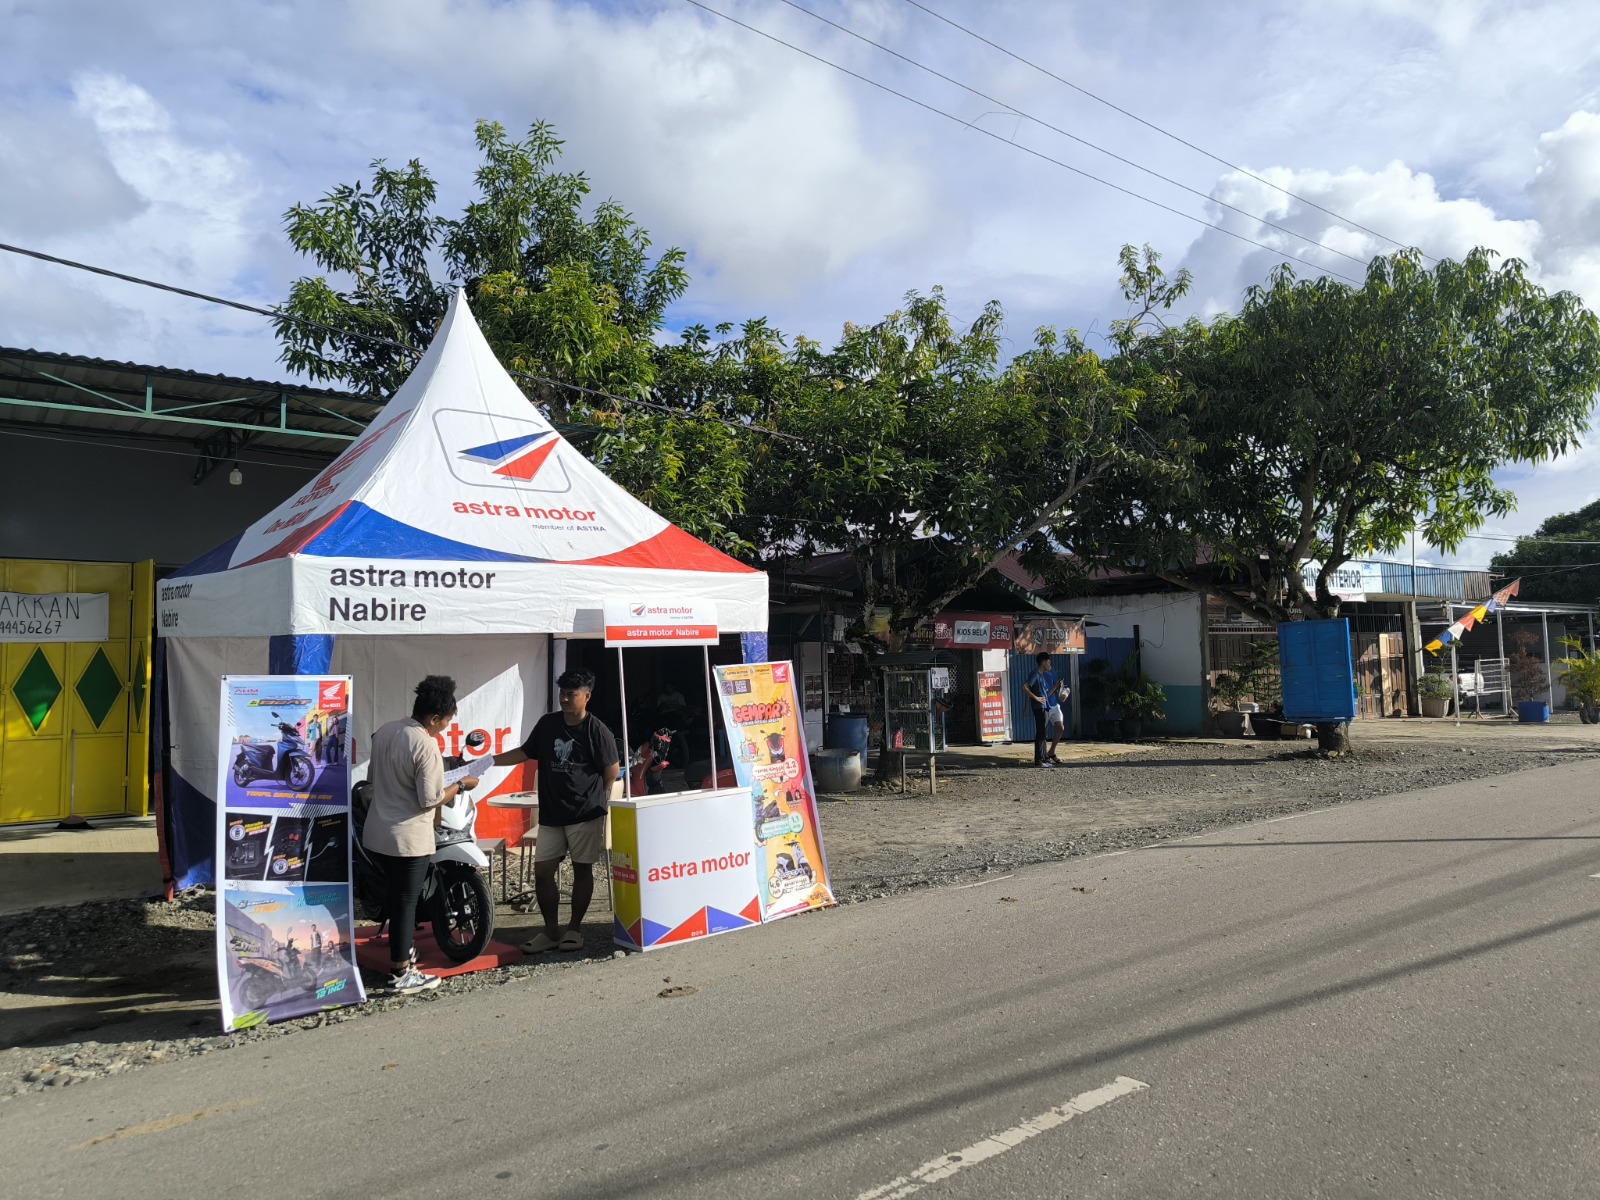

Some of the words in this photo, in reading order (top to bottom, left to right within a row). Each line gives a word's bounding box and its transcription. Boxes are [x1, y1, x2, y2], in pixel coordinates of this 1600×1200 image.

[452, 500, 520, 518] astra
[524, 506, 596, 522] motor
[330, 565, 406, 587] astra
[414, 568, 496, 589] motor
[161, 584, 174, 601] astra
[174, 581, 193, 600] motor
[161, 608, 179, 628] Nabire
[329, 597, 427, 622] Nabire
[647, 606, 668, 614] astra
[669, 606, 693, 614] motor
[676, 628, 700, 636] Nabire
[957, 628, 972, 636] KIOS
[972, 629, 988, 637] BELA
[991, 631, 1010, 641] SERU
[1045, 628, 1069, 640] TROY
[733, 703, 781, 723] GEMPAR
[785, 761, 797, 769] 2.2
[648, 861, 698, 882] astra
[701, 851, 751, 874] motor
